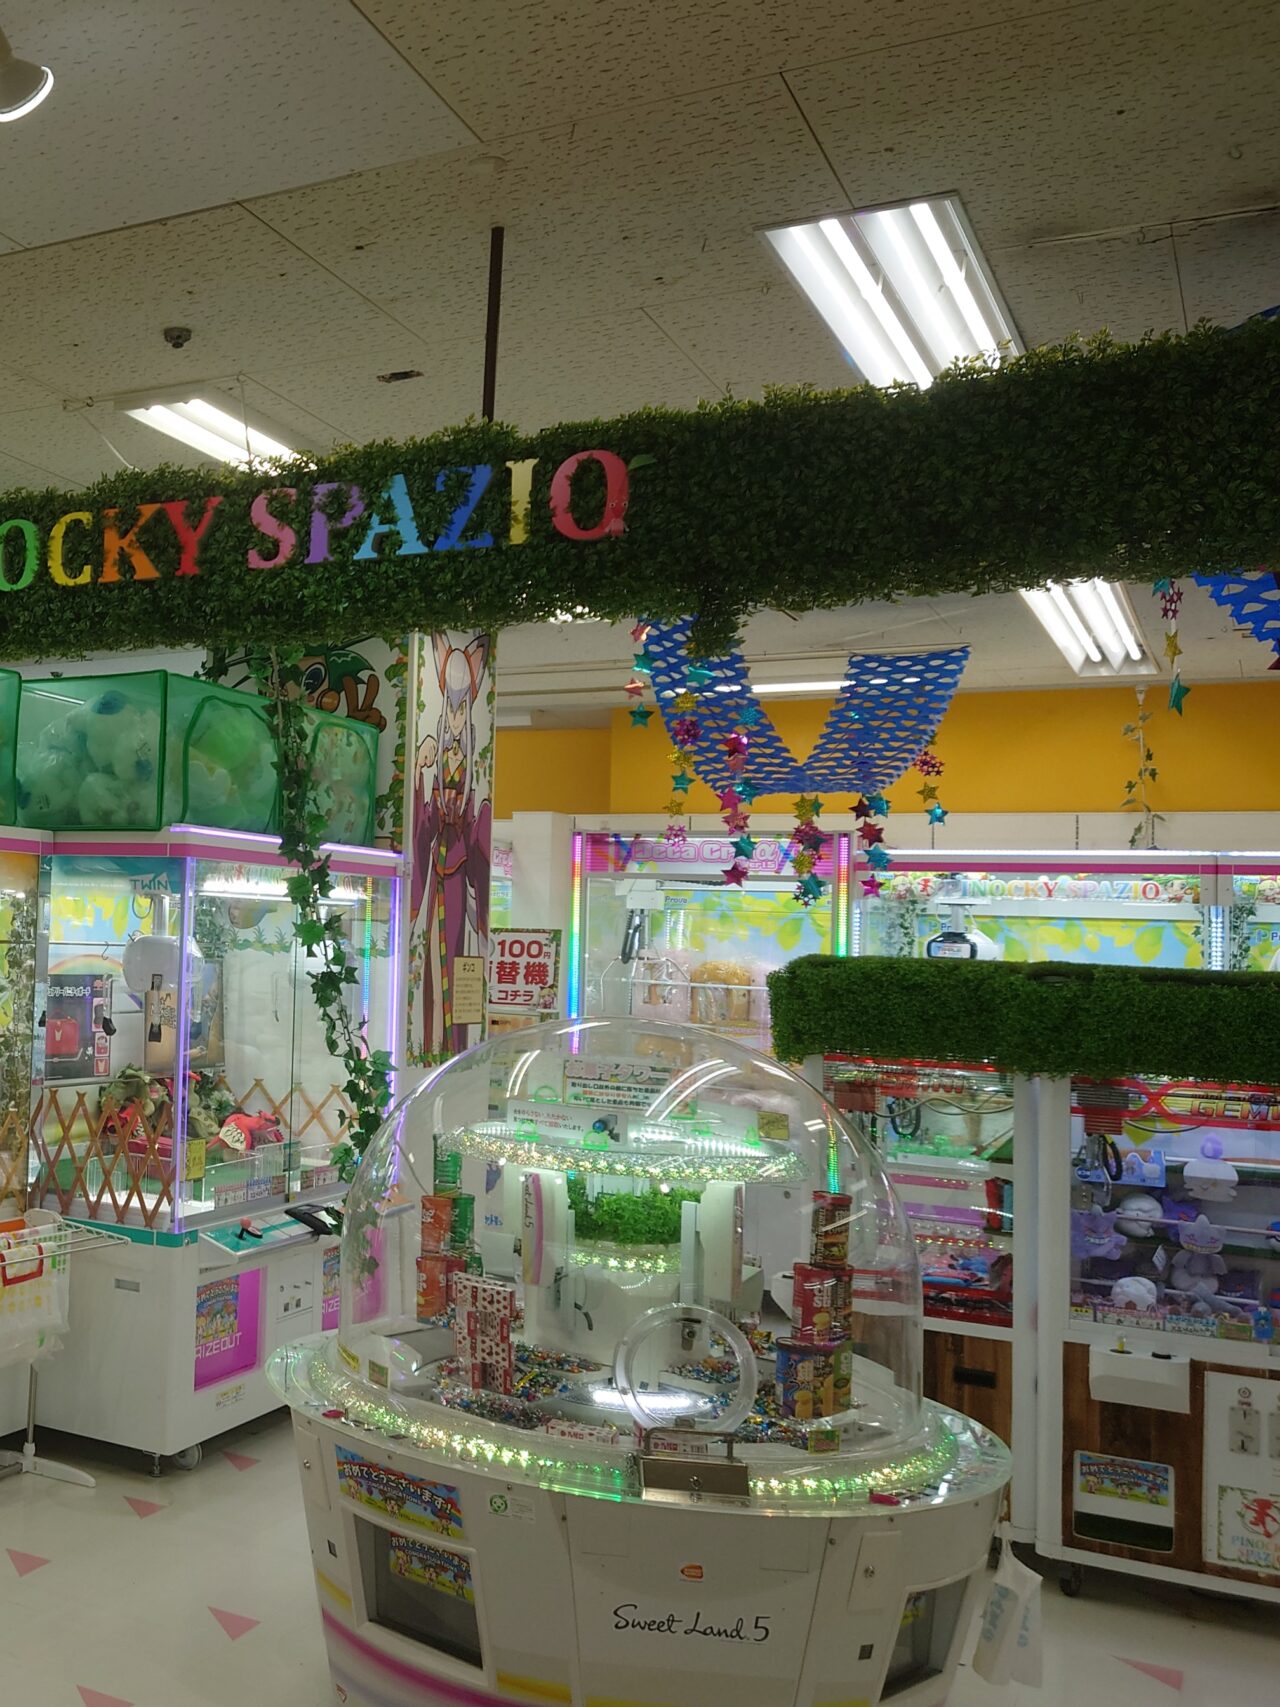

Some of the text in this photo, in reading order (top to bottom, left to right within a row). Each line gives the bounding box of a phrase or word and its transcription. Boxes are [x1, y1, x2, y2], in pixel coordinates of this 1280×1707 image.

[247, 448, 630, 572] SPAZIO
[634, 841, 697, 862] Deca
[129, 878, 168, 891] TWIN
[942, 879, 1161, 899] PINOCKY SPAZIO
[497, 939, 551, 959] 100円
[497, 989, 535, 1003] コチラ
[612, 1602, 772, 1643] Sweet Land 5
